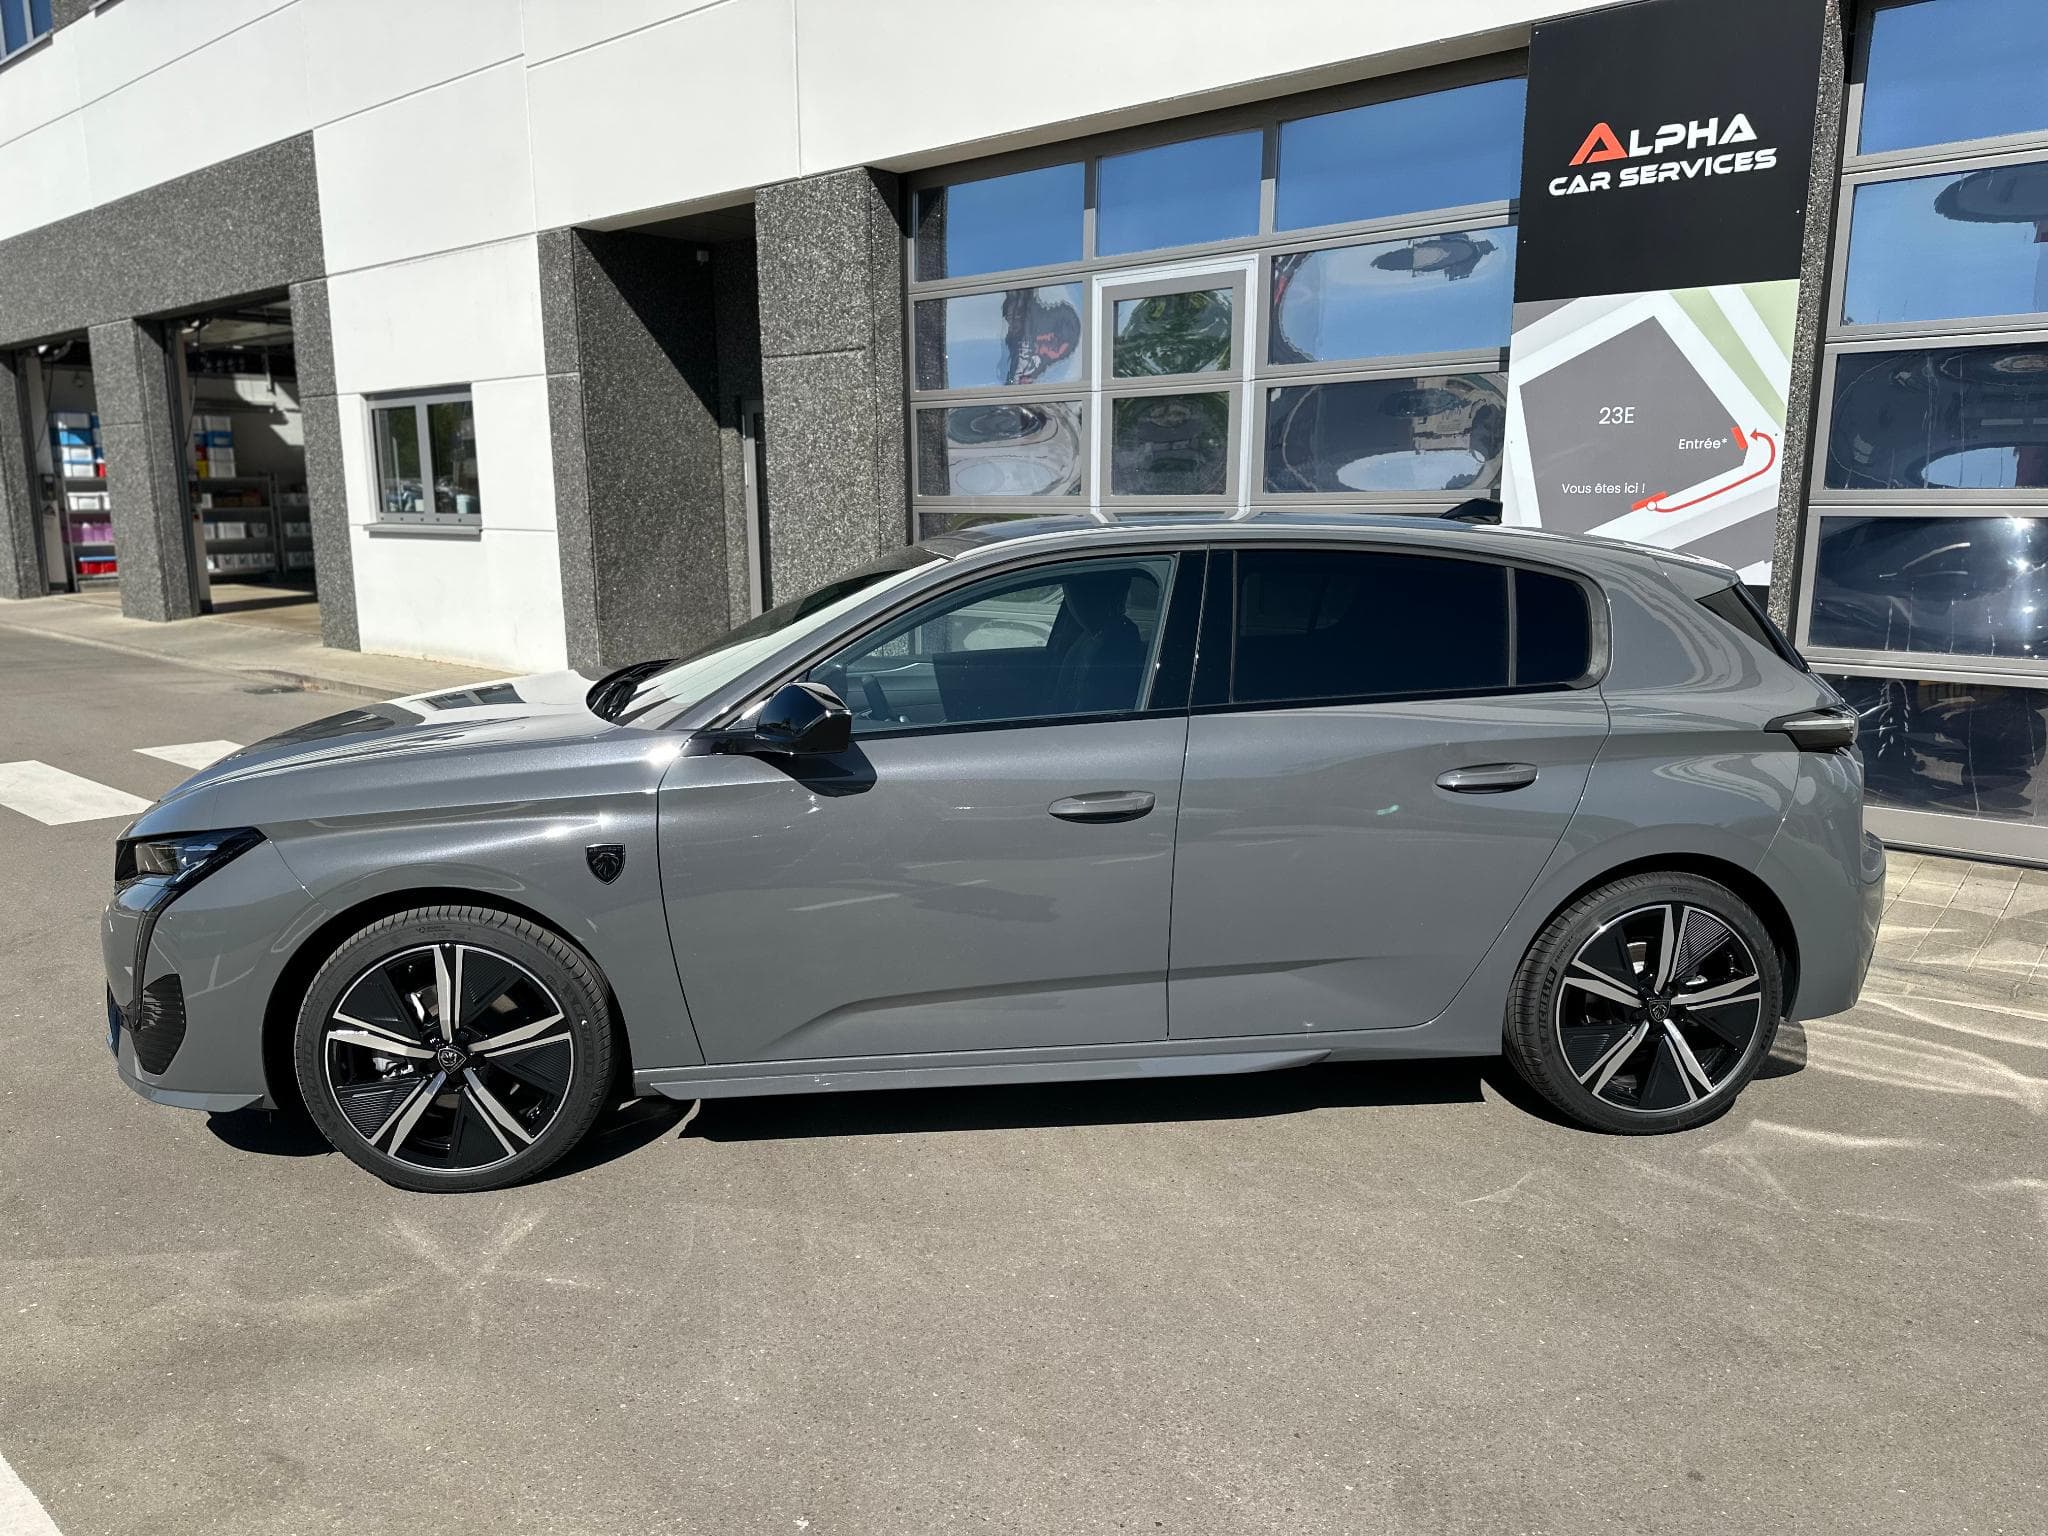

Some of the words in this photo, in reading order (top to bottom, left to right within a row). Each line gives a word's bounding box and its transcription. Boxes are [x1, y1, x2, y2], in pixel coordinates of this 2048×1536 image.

[1568, 113, 1758, 166] ALPHA
[1548, 171, 1611, 196] CAR
[1618, 148, 1778, 188] SERVICES
[1598, 406, 1636, 425] 23E
[1561, 483, 1592, 494] Vous
[1594, 482, 1621, 494] êtes
[1624, 482, 1639, 494] ici
[1641, 483, 1646, 494] !
